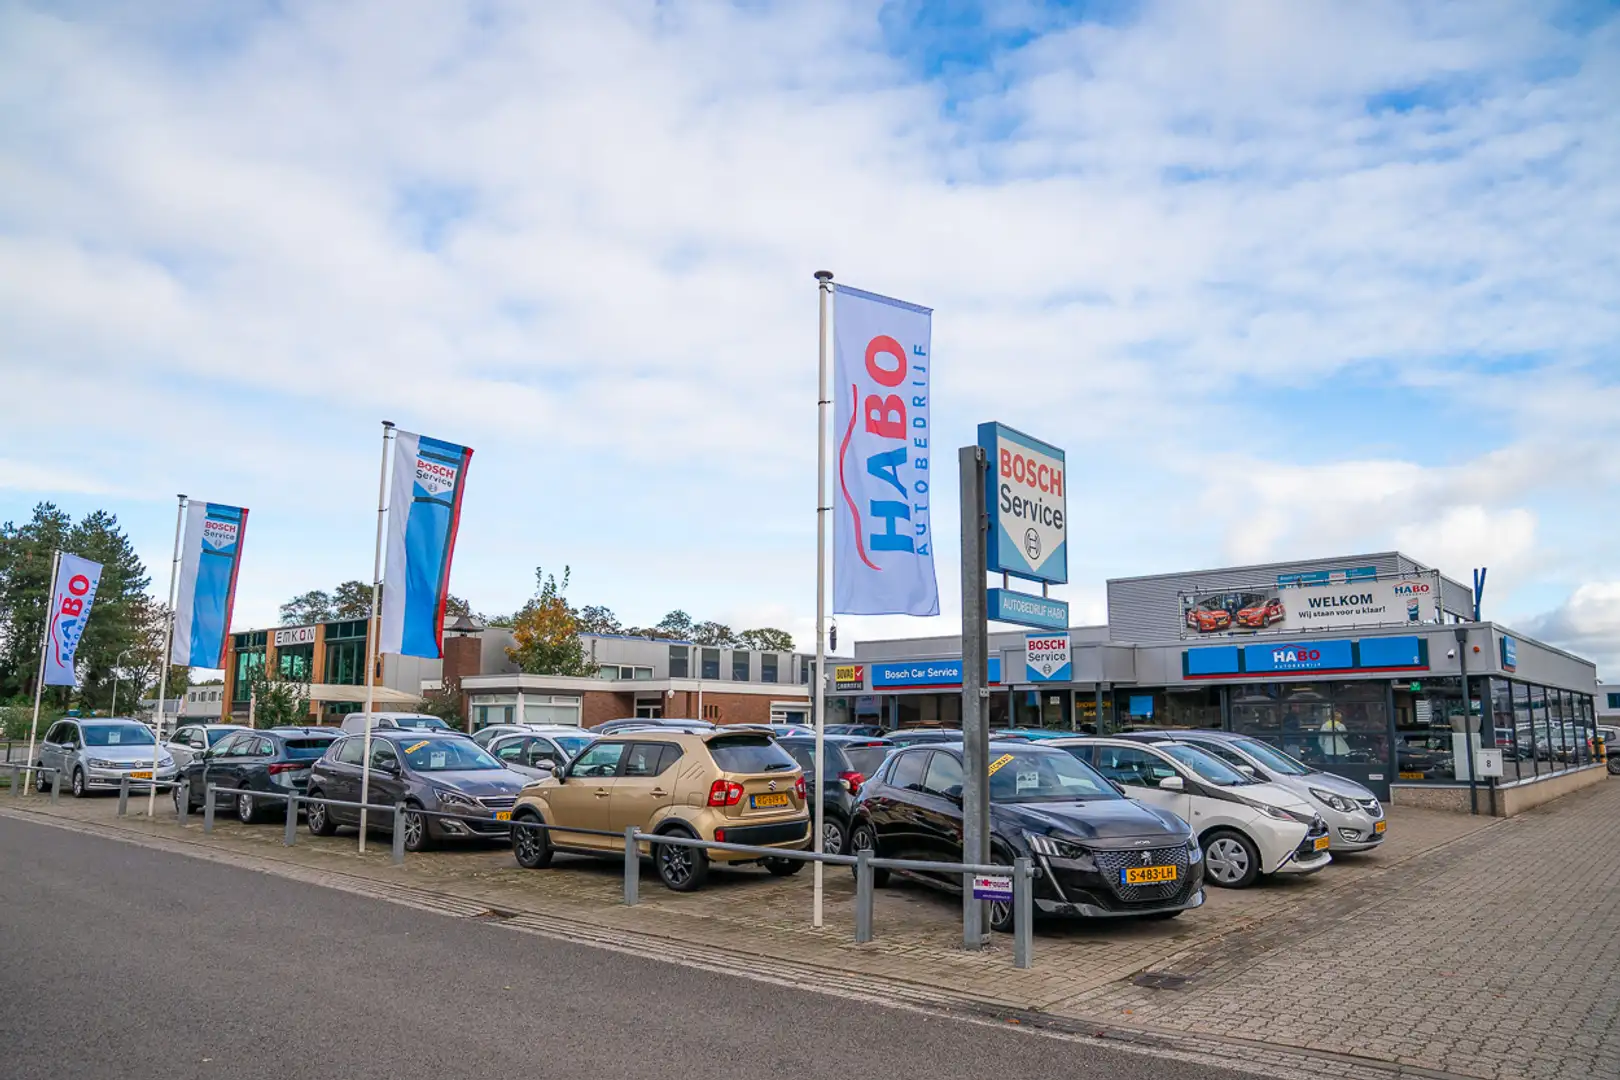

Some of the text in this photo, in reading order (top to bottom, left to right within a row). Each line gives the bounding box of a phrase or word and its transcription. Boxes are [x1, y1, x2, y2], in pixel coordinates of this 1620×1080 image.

[864, 335, 915, 554] HABO
[912, 344, 930, 556] AUTOBEDRIJF
[417, 459, 455, 479] BOSCH
[1000, 448, 1063, 497] BOSCH
[416, 469, 453, 488] Service
[1000, 483, 1064, 530] Service
[205, 520, 236, 533] BOSCH
[203, 529, 235, 540] Service
[1394, 584, 1430, 594] HABO
[1308, 593, 1373, 608] WELKOM
[1003, 598, 1066, 620] AUTOBEDRIJF HABO
[1299, 611, 1312, 619] Wij
[1336, 608, 1354, 616] voor
[1362, 605, 1386, 614] klaar!
[277, 629, 315, 643] EMKON
[1028, 639, 1066, 651] BOSCH
[1028, 651, 1066, 662] Service
[1273, 650, 1321, 662] HABO
[885, 667, 958, 680] Bosch Car Service
[1130, 867, 1173, 881] S-483-LH
